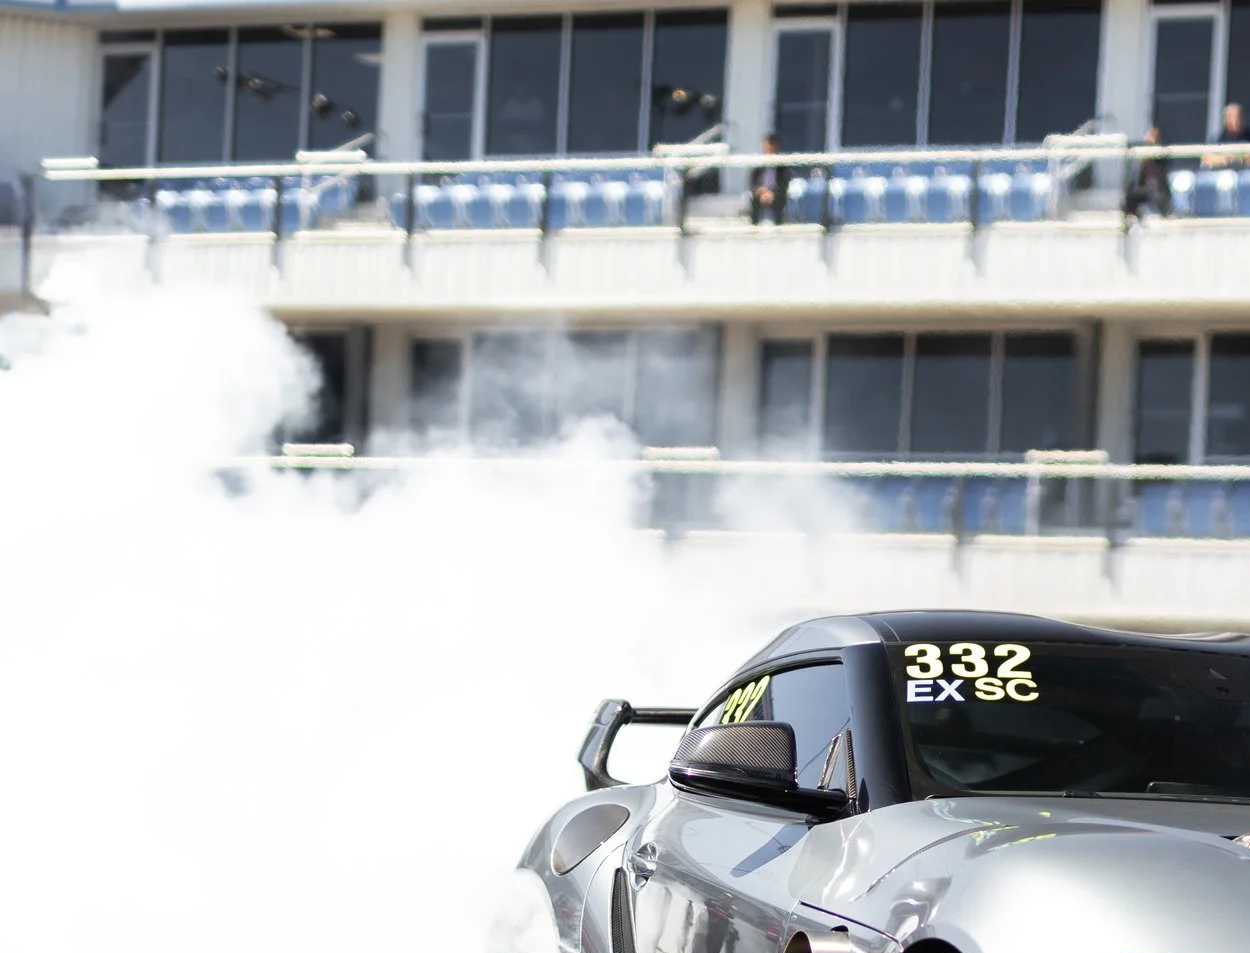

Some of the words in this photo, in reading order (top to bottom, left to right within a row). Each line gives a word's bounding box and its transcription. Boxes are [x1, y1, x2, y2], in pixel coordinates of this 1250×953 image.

[904, 643, 1032, 679] 332
[907, 679, 965, 702] EX
[974, 677, 1039, 701] SC
